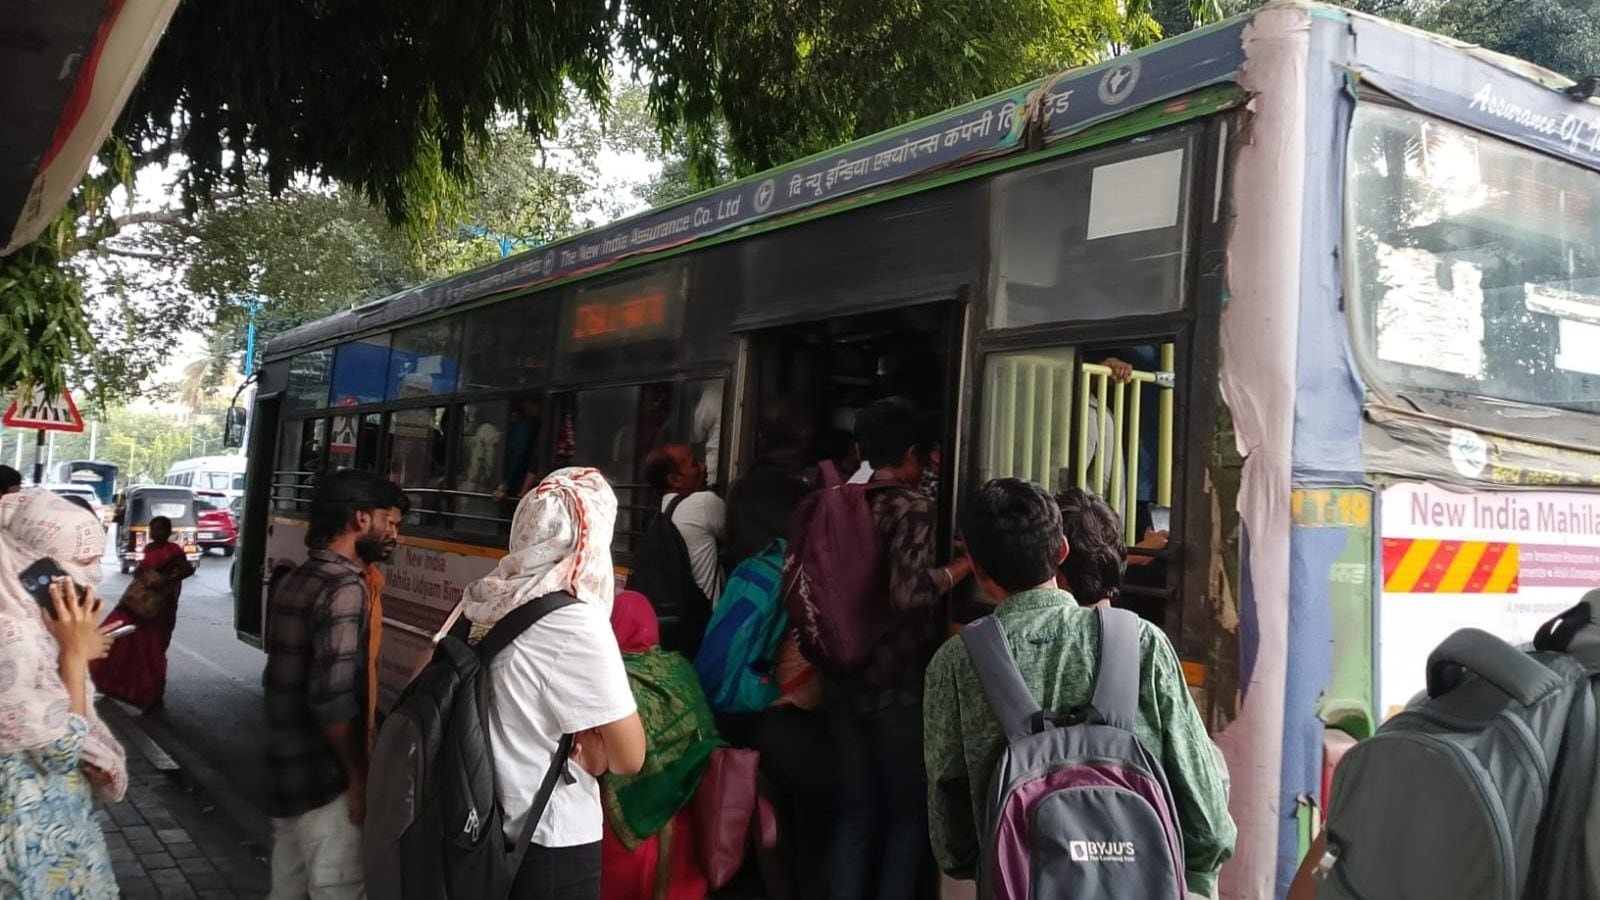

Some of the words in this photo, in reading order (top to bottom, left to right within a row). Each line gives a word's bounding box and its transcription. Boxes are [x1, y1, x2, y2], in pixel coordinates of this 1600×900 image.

[1468, 83, 1560, 135] Assurance
[788, 174, 801, 198] दि
[805, 172, 823, 196] न्यू
[944, 110, 993, 147] कंपनी
[560, 250, 576, 267] The
[579, 243, 601, 262] New
[601, 234, 628, 257] India
[631, 214, 690, 244] Assurance
[693, 207, 714, 227] Co.
[717, 195, 742, 221] Ltd
[1410, 492, 1465, 526] New
[1473, 496, 1531, 532] India
[406, 547, 423, 568] New
[424, 552, 446, 573] India
[443, 580, 464, 603] Bim
[1088, 841, 1135, 855] BYJU'S
